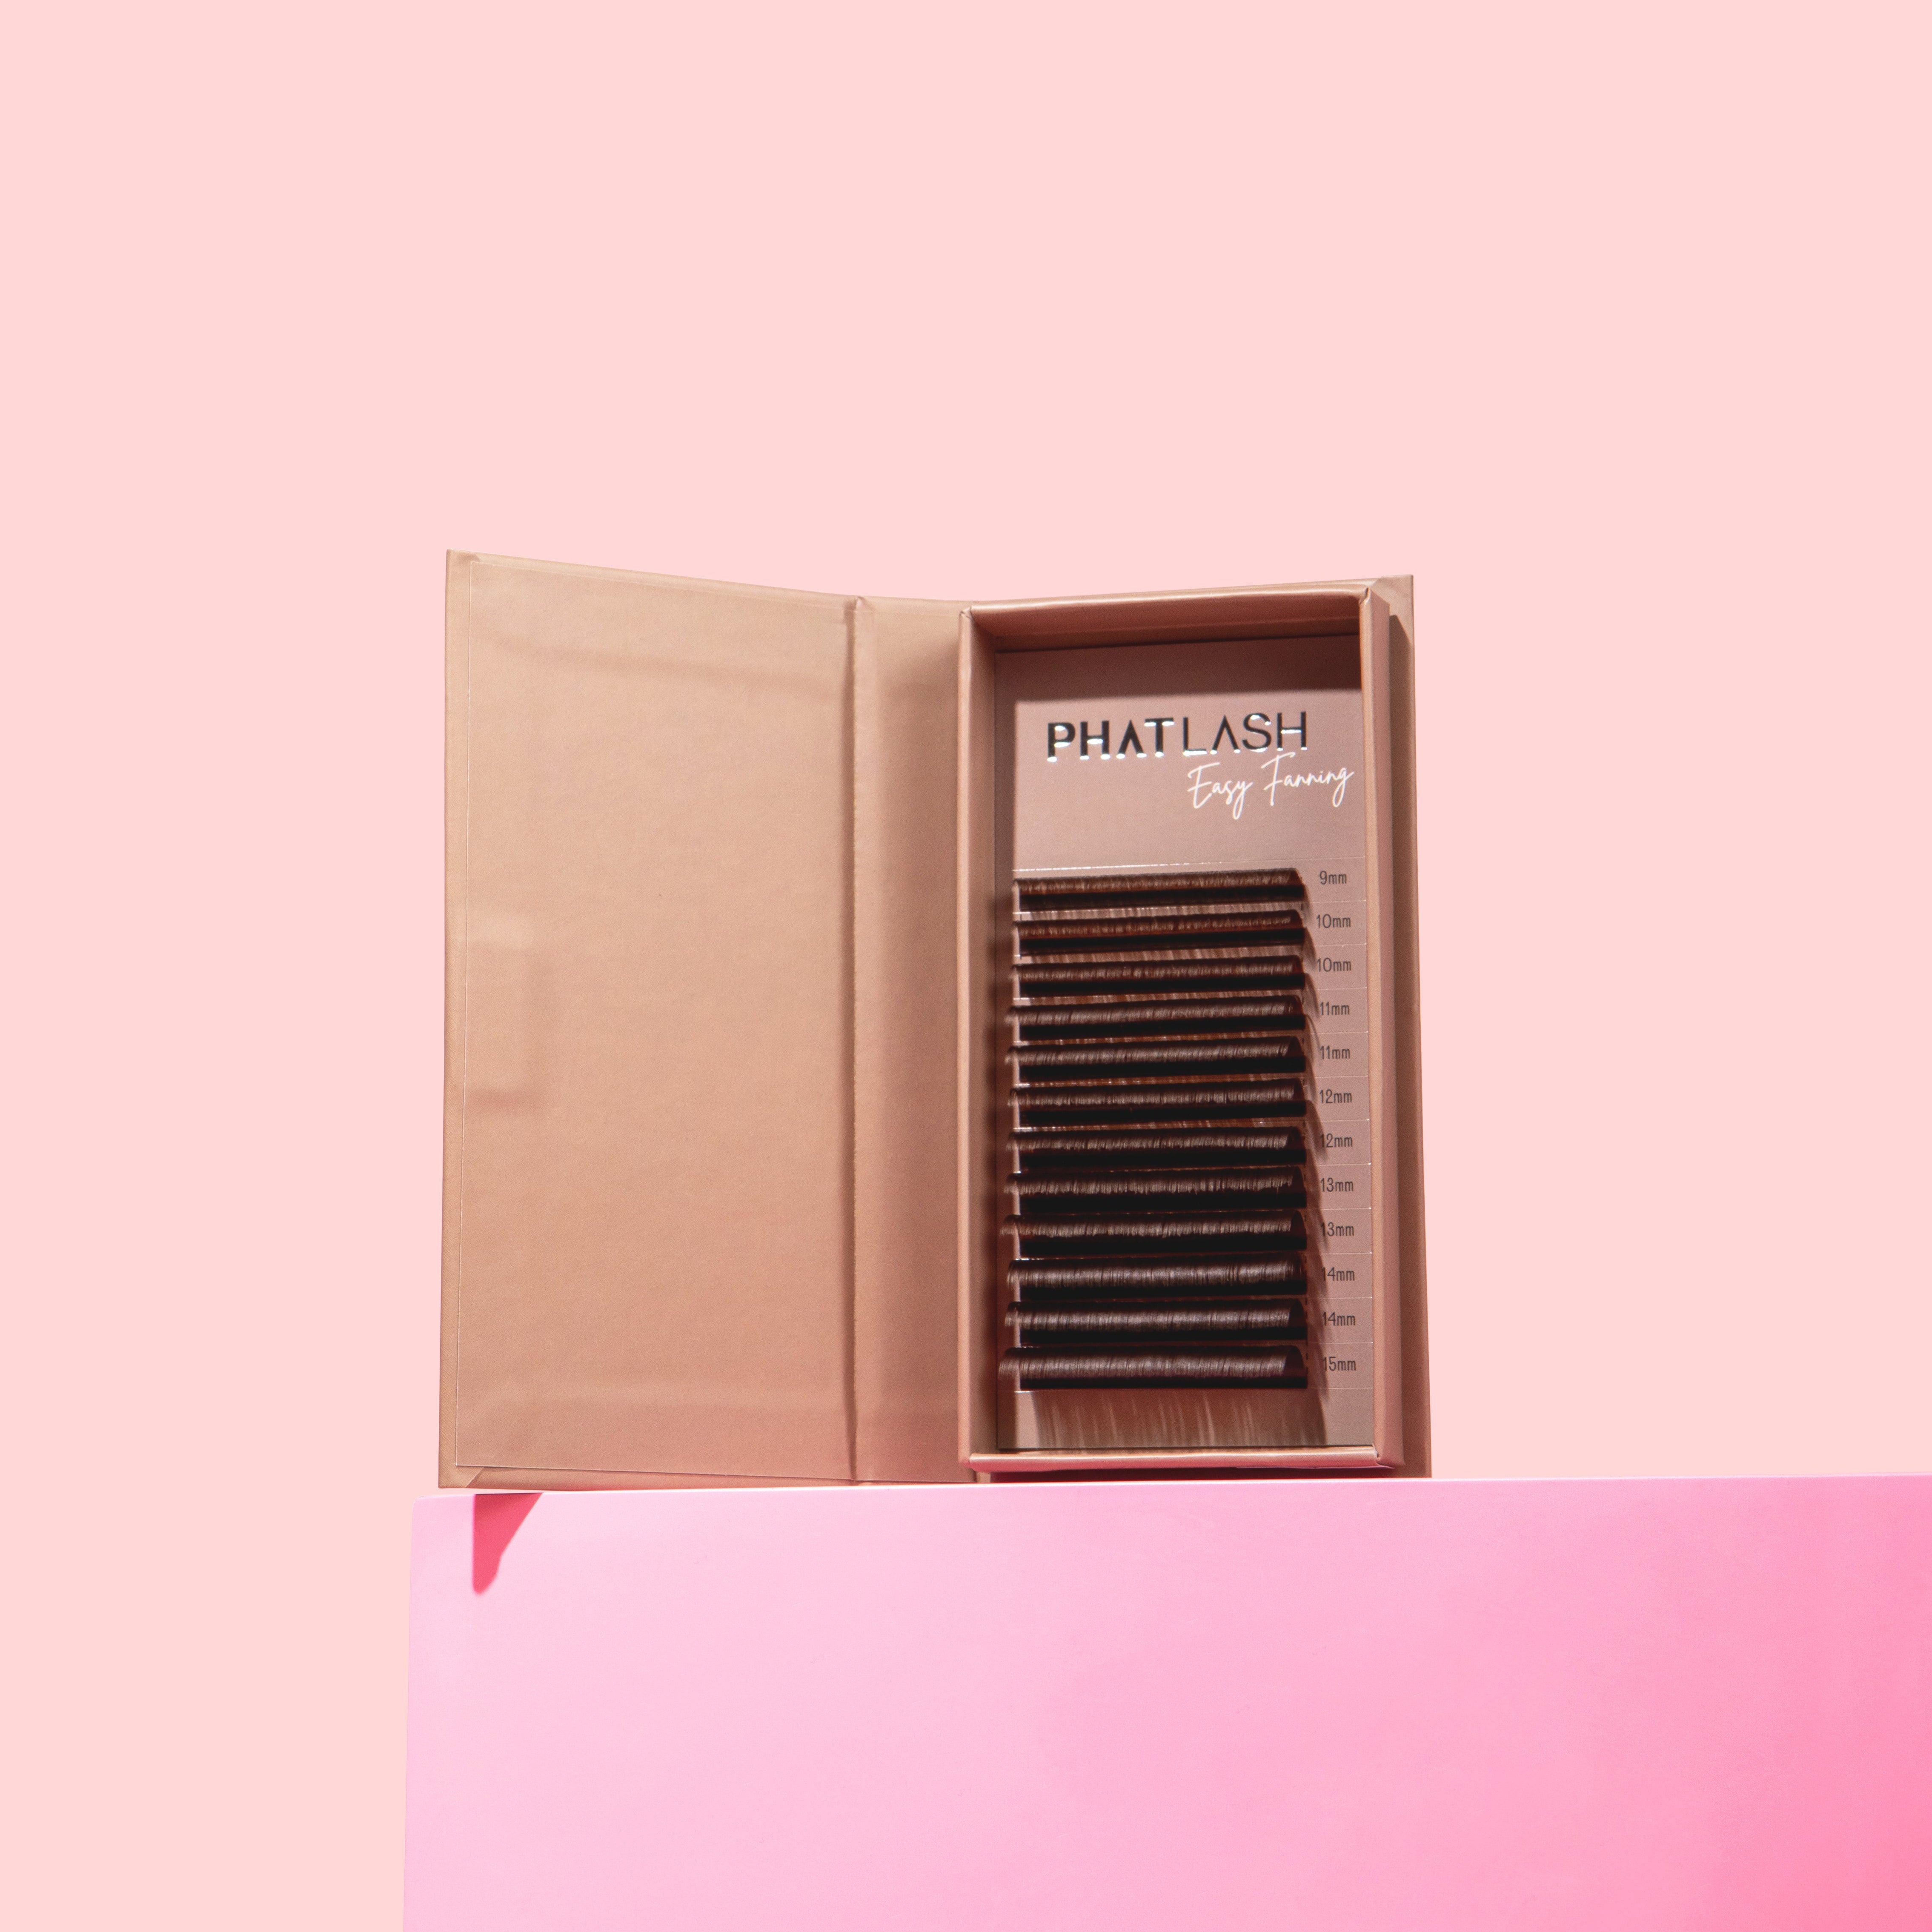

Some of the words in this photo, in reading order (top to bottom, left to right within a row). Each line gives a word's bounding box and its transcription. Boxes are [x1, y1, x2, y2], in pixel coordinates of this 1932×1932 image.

[1187, 762, 1254, 820] Easy
[1261, 752, 1354, 808] Fanning
[1319, 870, 1347, 884] 9mm
[1316, 914, 1351, 929] 10mm
[1317, 958, 1352, 972] 10mm
[1319, 1002, 1350, 1016] 11mm
[1320, 1046, 1351, 1059] 11mm
[1319, 1090, 1352, 1104] 12mm
[1320, 1133, 1353, 1148] 12mm
[1320, 1178, 1354, 1192] 13mm
[1321, 1222, 1354, 1236] 13mm
[1321, 1267, 1355, 1281] 14mm
[1322, 1312, 1356, 1326] 14mm
[1322, 1357, 1357, 1371] 15mm
